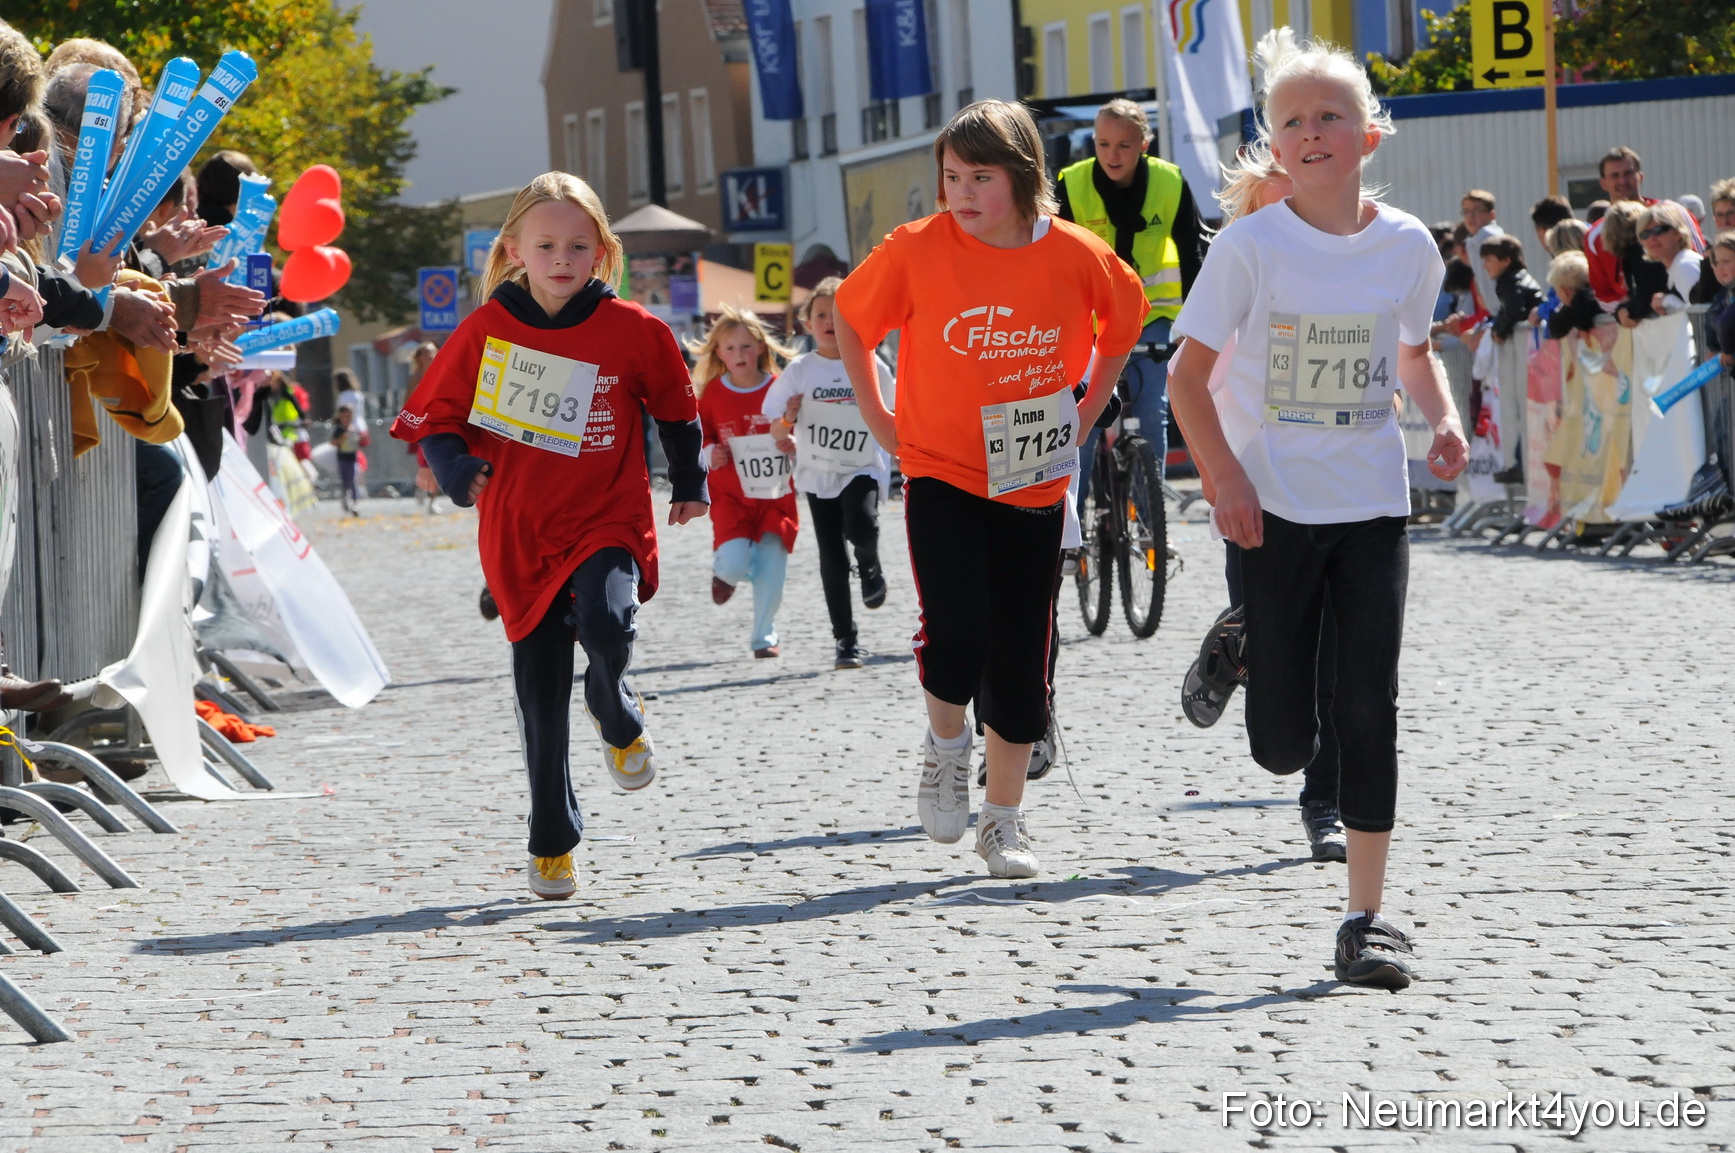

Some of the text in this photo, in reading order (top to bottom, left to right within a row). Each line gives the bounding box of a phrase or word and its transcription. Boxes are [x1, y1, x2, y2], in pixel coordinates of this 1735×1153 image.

[1493, 1, 1533, 60] B
[211, 66, 246, 94] maxi
[214, 96, 230, 110] dsl
[94, 116, 110, 128] dsl
[94, 108, 209, 251] www.maxi-dsl.de
[764, 262, 783, 291] C
[424, 312, 456, 327] TAXI
[967, 324, 1061, 349] Fischer
[1306, 323, 1370, 345] Antonia
[511, 352, 547, 381] Lucy
[1272, 353, 1290, 370] K3
[482, 369, 496, 386] K3
[998, 369, 1022, 385] und
[1024, 364, 1042, 377] das
[1307, 356, 1389, 389] 7184
[594, 385, 612, 395] AUF
[507, 381, 579, 423] 7193
[1013, 408, 1045, 426] Anna
[584, 424, 616, 434] 9.09.2010
[807, 423, 869, 453] 10207
[534, 432, 579, 451] PFLEIDERER
[989, 438, 1004, 454] K3
[1015, 421, 1072, 461] 7123
[1044, 458, 1077, 475] PFLEIDERER
